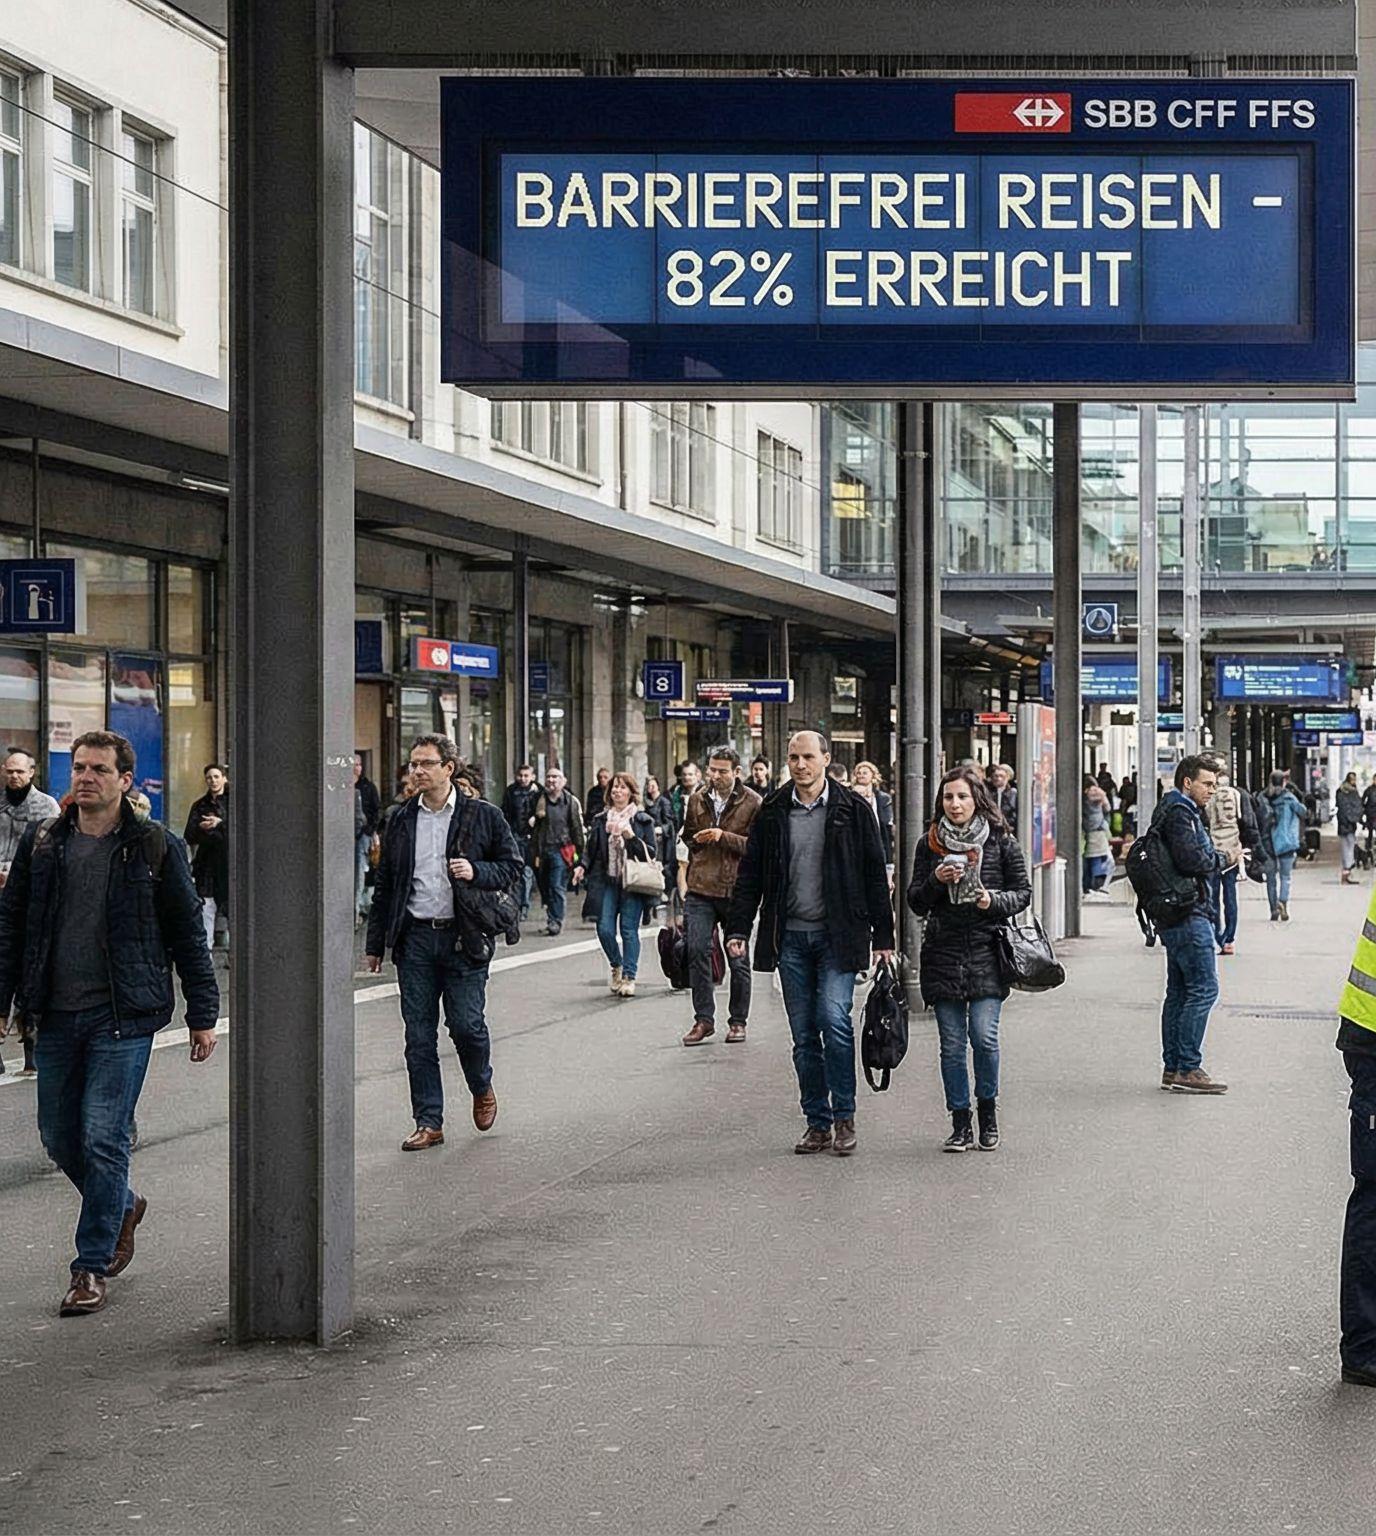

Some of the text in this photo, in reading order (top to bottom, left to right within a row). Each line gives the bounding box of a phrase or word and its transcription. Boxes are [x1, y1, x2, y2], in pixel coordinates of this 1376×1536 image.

[1084, 99, 1315, 129] SBB CFF FFS
[517, 172, 965, 229] BARRIEREFREI
[999, 173, 1220, 229] REISEN
[667, 250, 1132, 307] 82% ERREICHT
